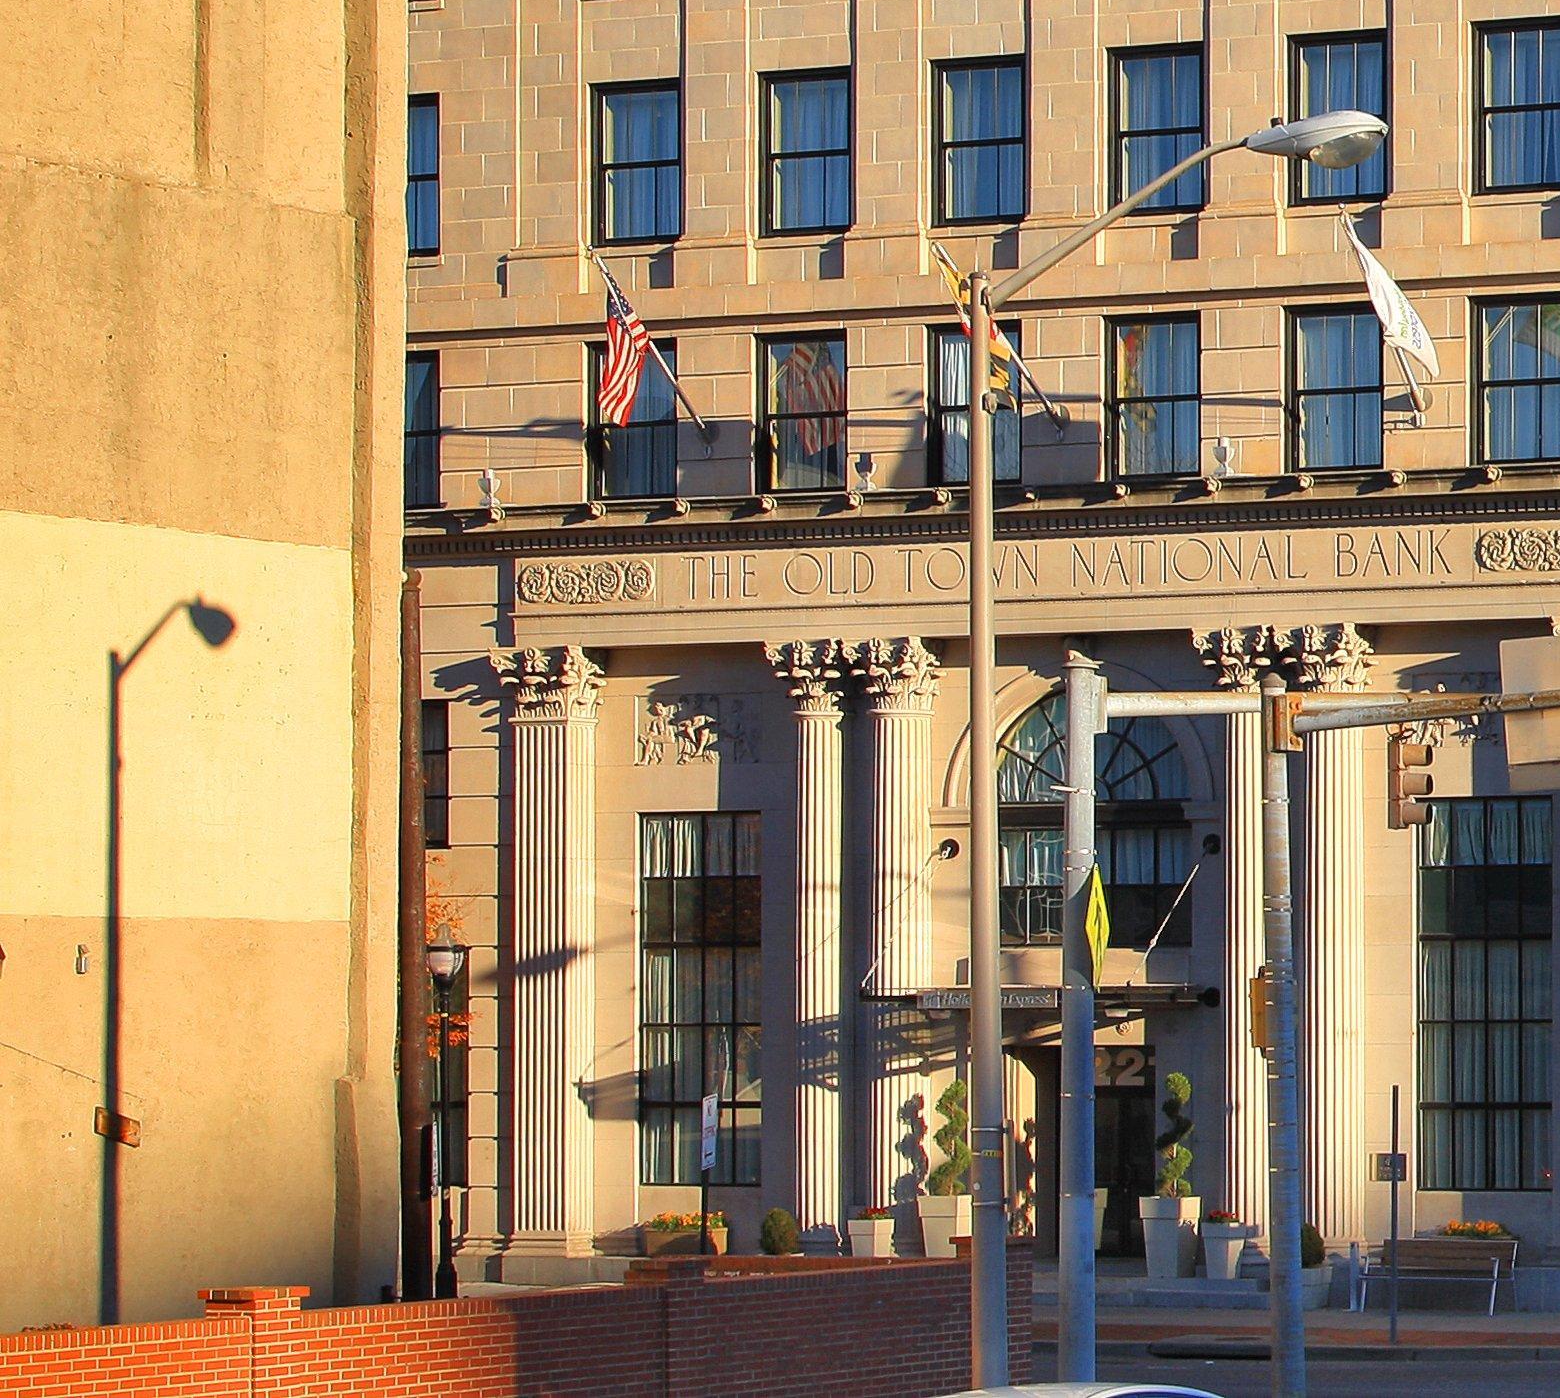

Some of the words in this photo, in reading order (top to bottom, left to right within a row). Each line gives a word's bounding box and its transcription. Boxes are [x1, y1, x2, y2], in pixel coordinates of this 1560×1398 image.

[680, 553, 758, 601] THE
[782, 549, 875, 596] OLD
[1071, 534, 1309, 587] NATIONAL
[1334, 528, 1453, 578] BANK
